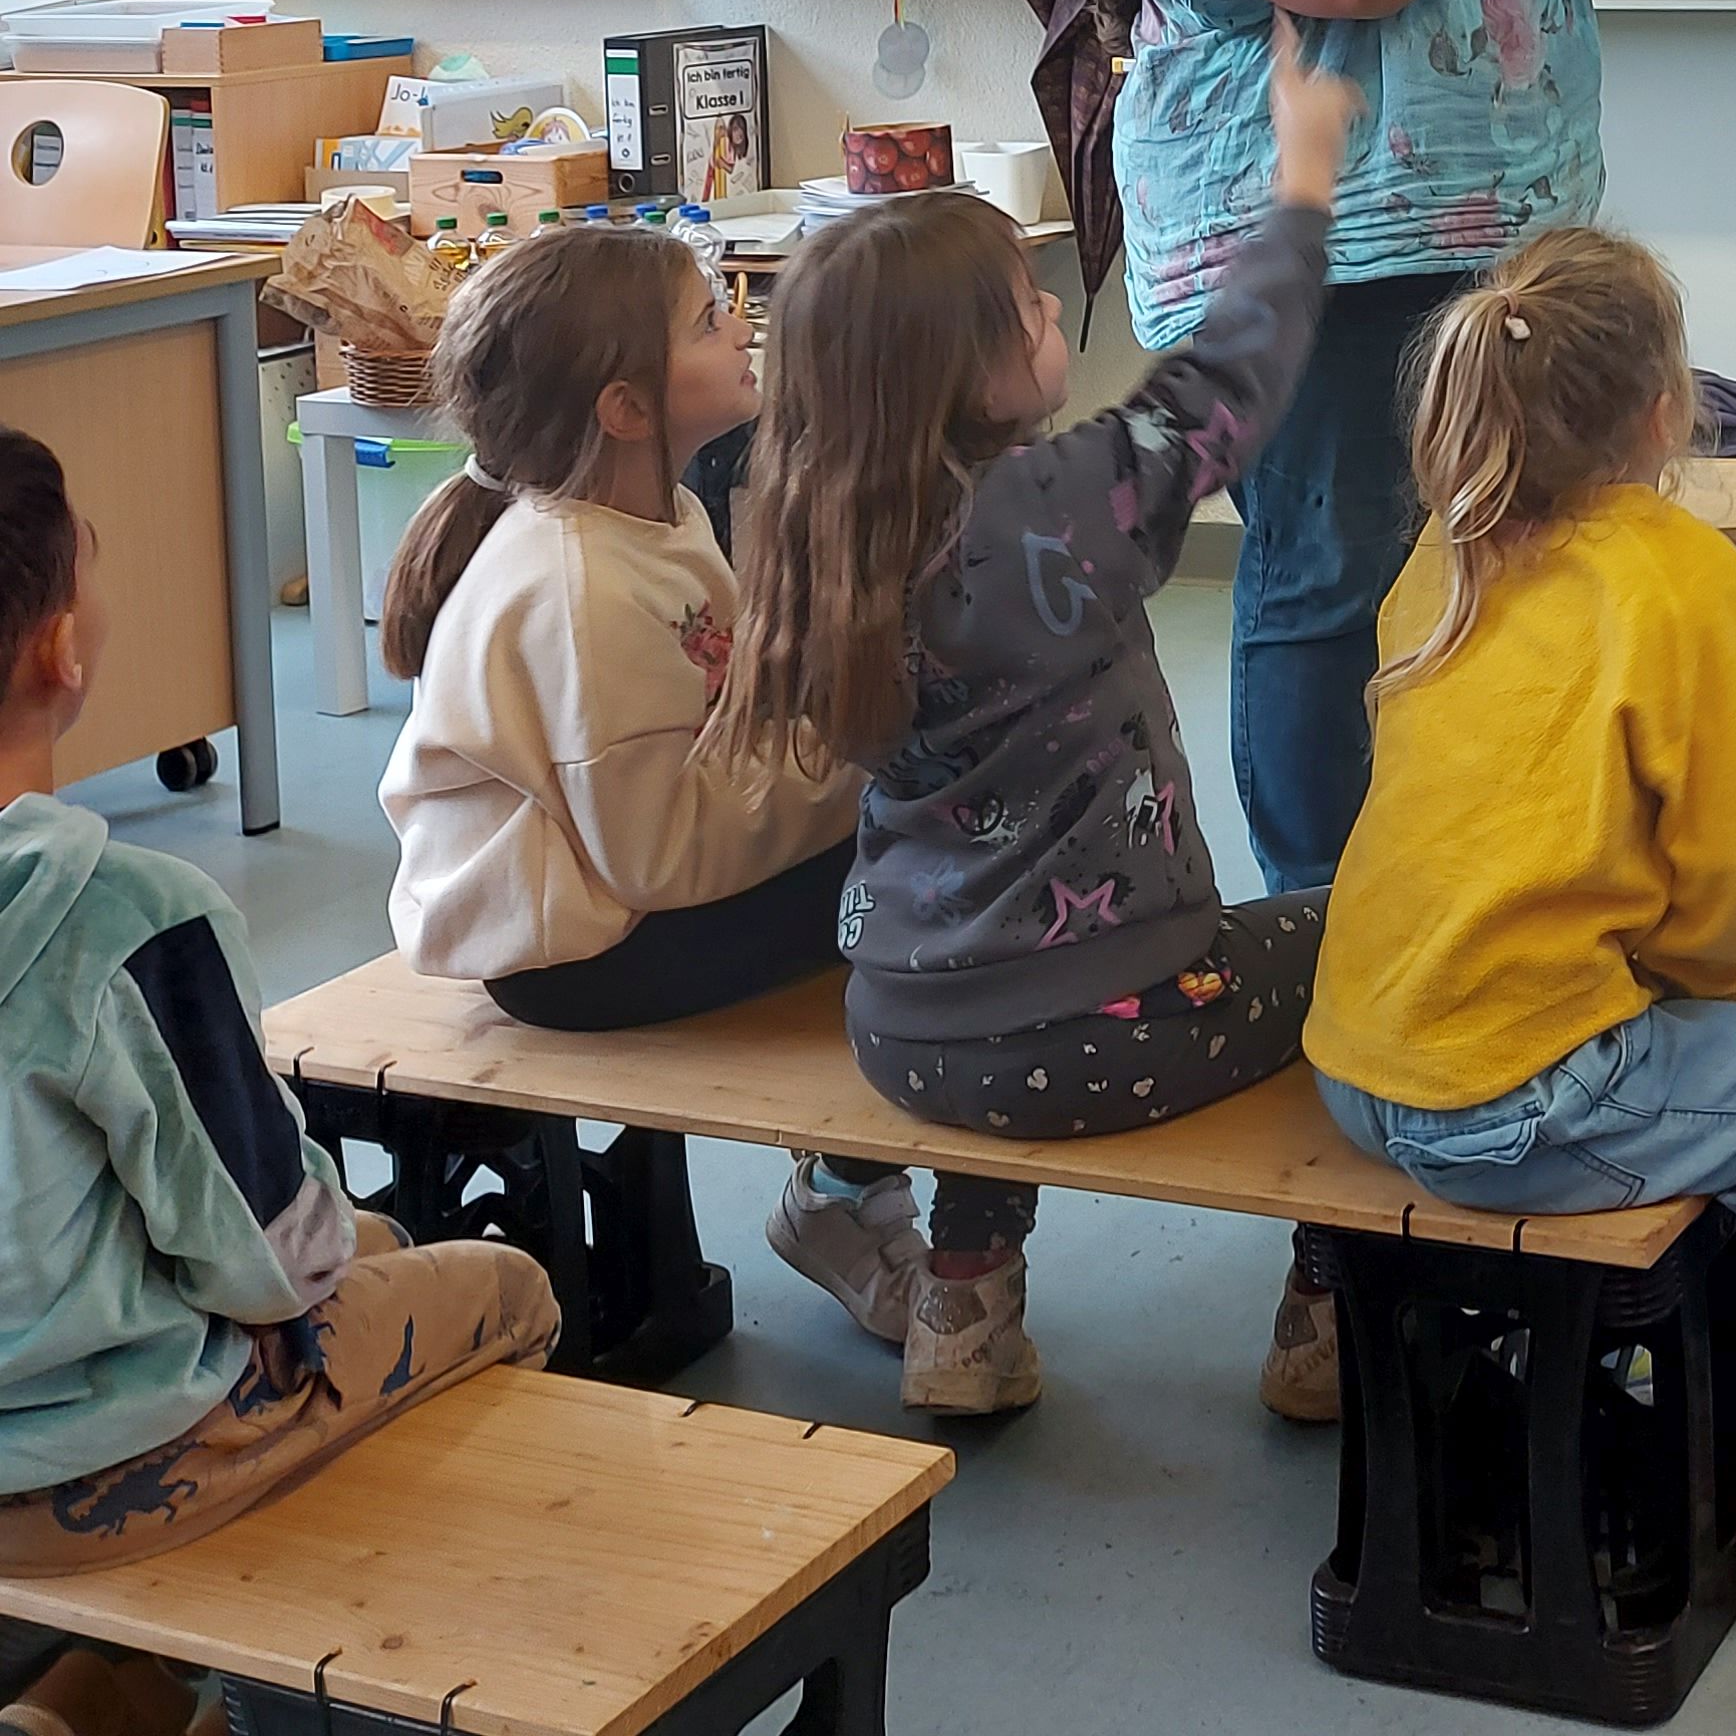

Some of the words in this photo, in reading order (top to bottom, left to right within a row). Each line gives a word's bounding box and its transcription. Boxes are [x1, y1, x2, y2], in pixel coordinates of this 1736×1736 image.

[704, 68, 721, 82] bin
[722, 65, 751, 81] fertig
[696, 93, 738, 111] Klasse
